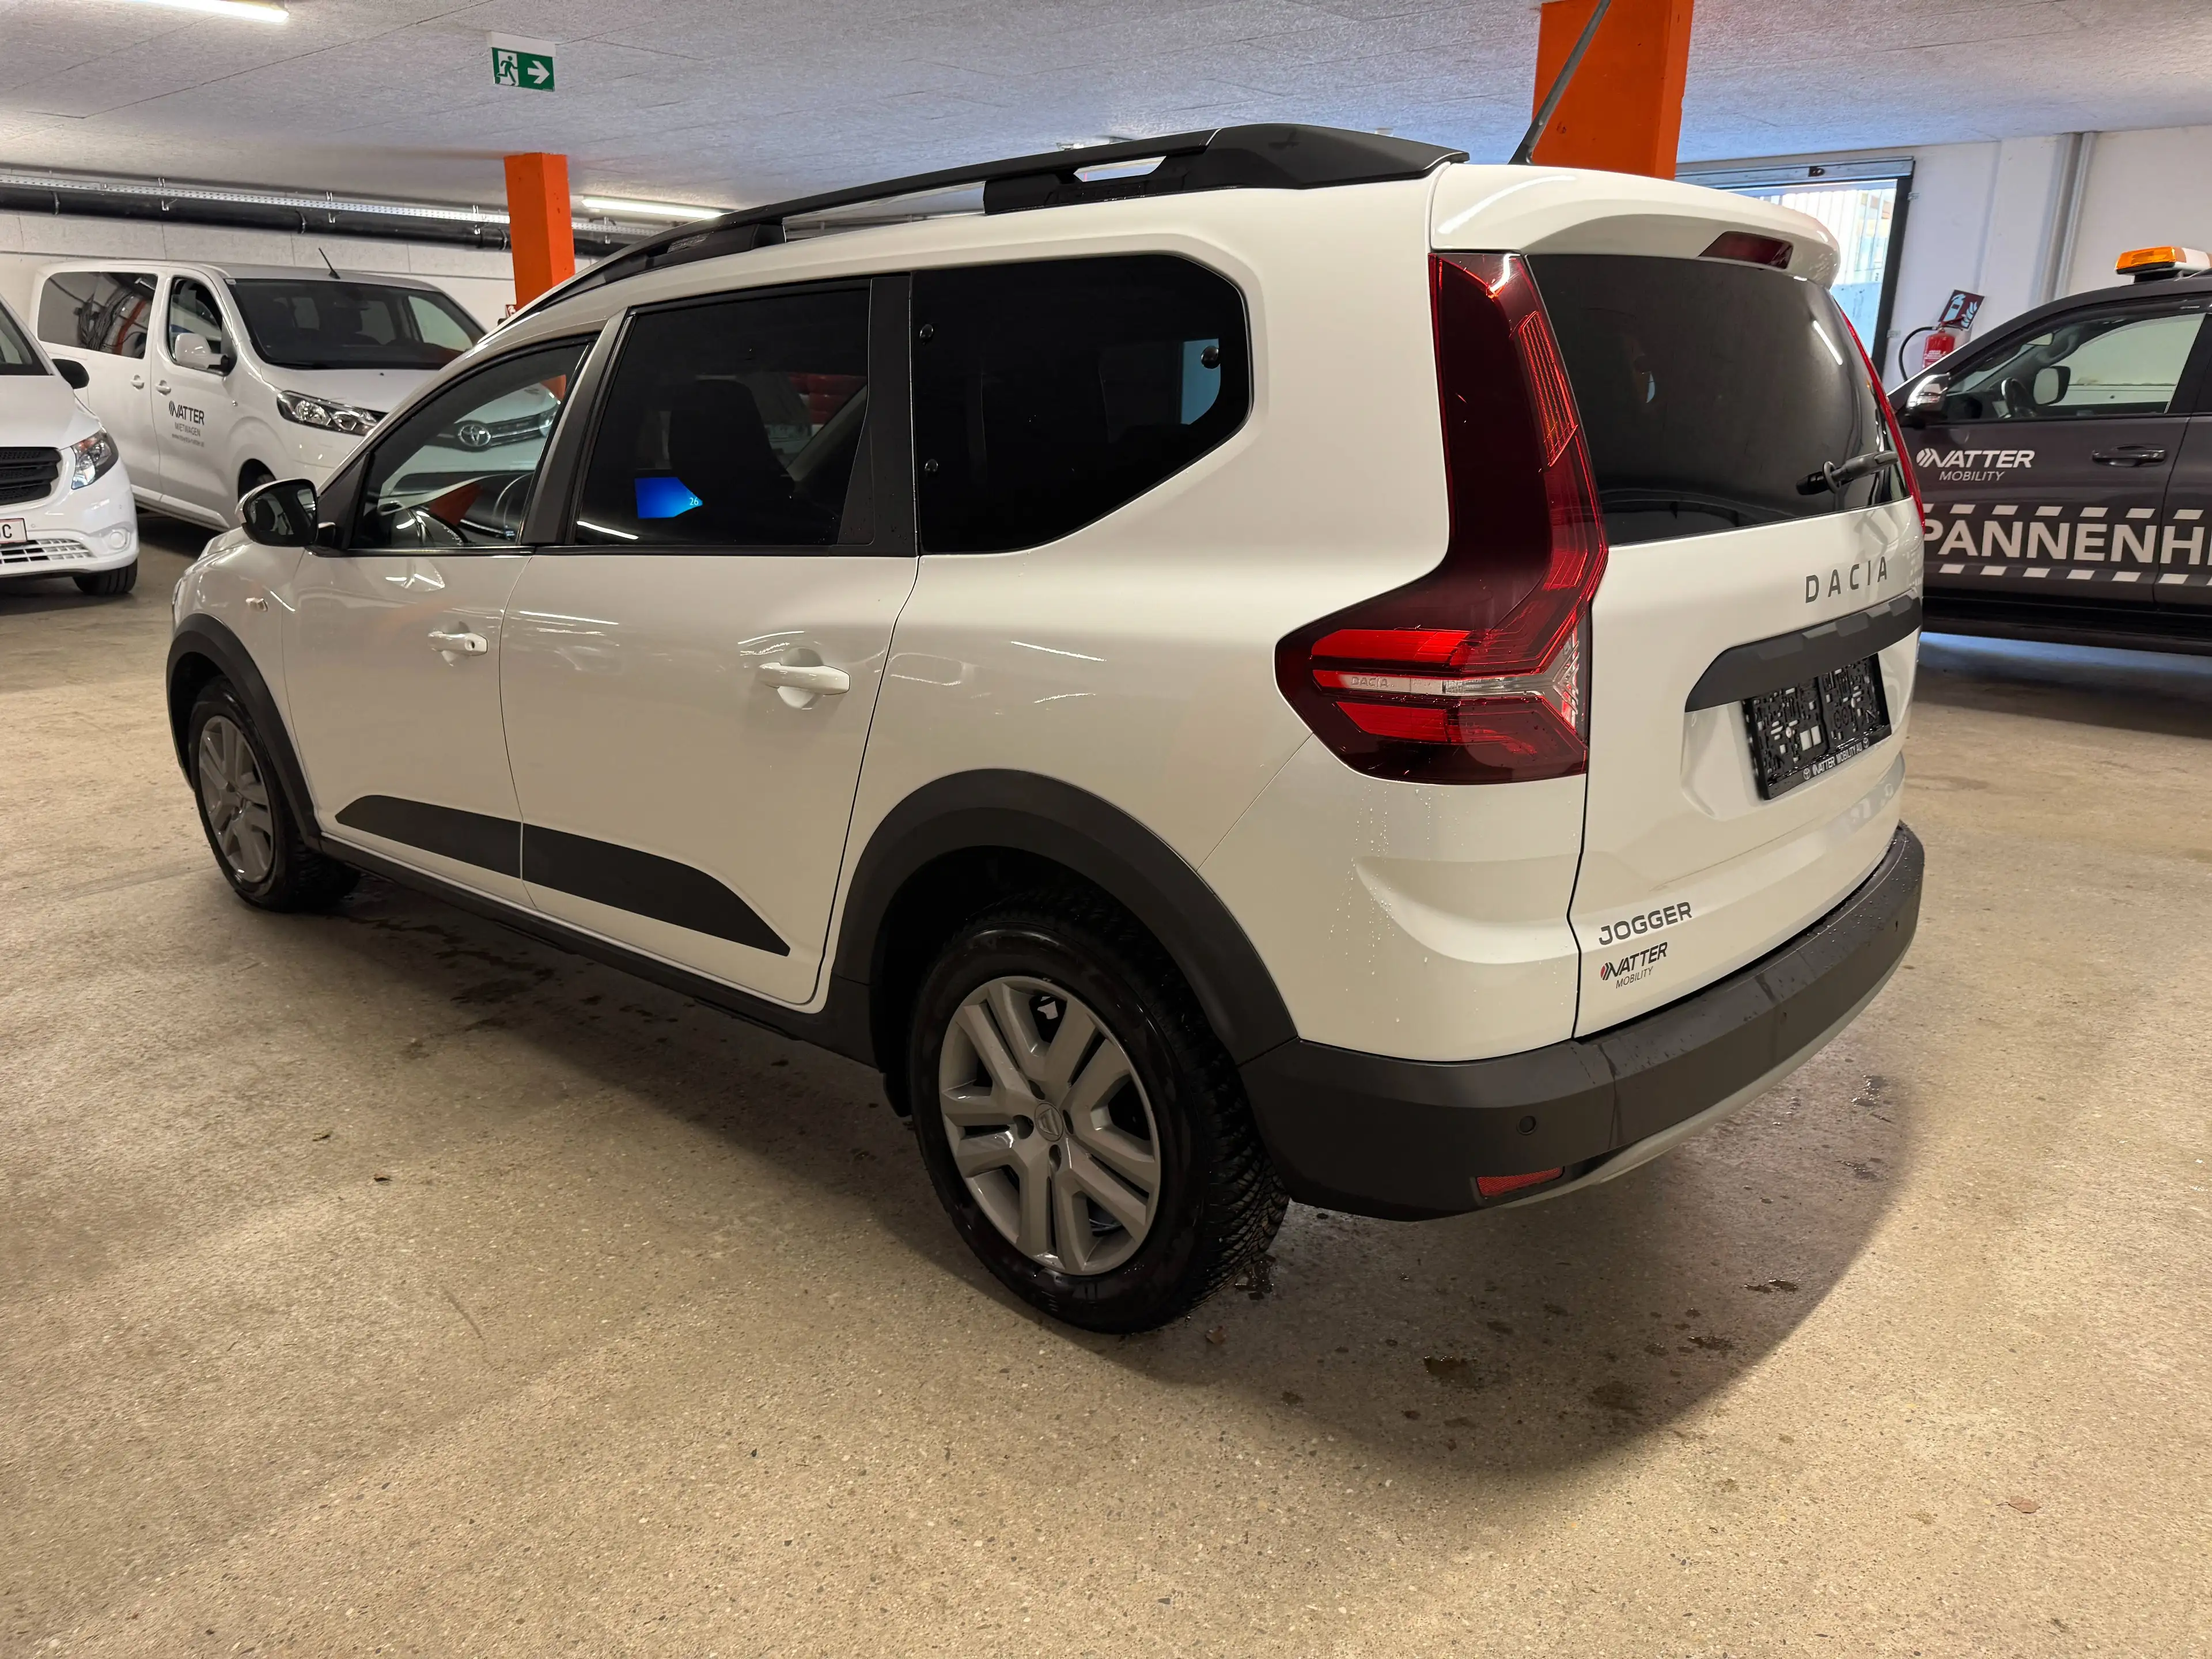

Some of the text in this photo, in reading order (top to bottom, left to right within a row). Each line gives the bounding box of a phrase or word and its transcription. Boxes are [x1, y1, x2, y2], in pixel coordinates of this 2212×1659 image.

[169, 400, 204, 425] NATTER
[1918, 448, 2035, 468] NATTER
[1939, 471, 2005, 481] MOBILITY
[689, 497, 699, 506] 26
[0, 524, 12, 539] C
[1805, 556, 1887, 603] DACIA
[1351, 676, 1389, 688] DACIA
[1813, 756, 1836, 775] NATTER
[1599, 902, 1692, 945] JOGGER
[1601, 942, 1668, 980] NATTER
[1616, 966, 1653, 988] MOBILITY
